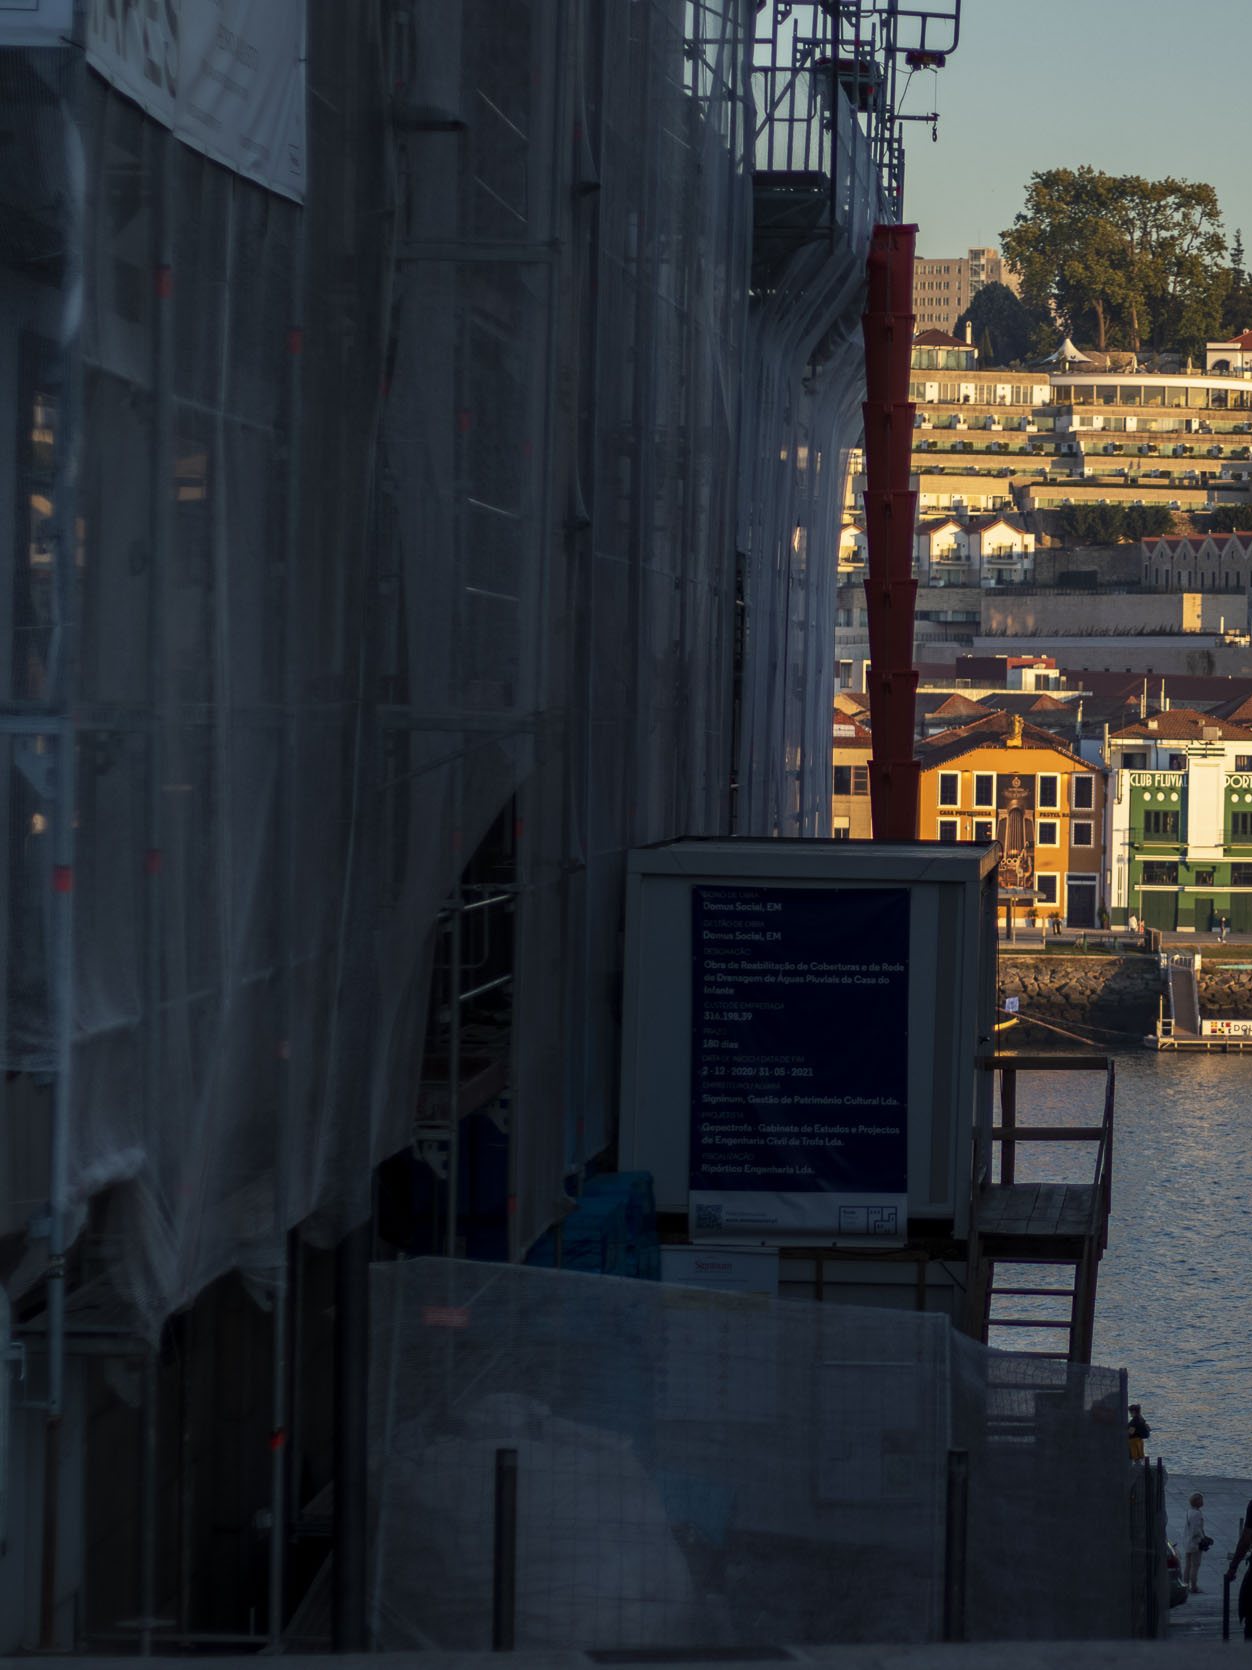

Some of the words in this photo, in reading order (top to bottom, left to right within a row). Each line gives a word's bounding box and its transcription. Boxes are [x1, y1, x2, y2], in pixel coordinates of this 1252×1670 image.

[1130, 774, 1153, 787] CLUB
[1155, 774, 1188, 788] FLUVIAL
[704, 902, 734, 911] Domus
[736, 902, 765, 912] Social,
[767, 903, 782, 911] EM
[704, 931, 734, 940] Domus
[736, 931, 765, 941] Social,
[766, 932, 782, 940] EM
[704, 960, 727, 969] Obra
[728, 961, 740, 969] de
[741, 961, 796, 971] Reabilitação
[797, 962, 809, 971] de
[810, 962, 860, 971] Coberturas
[882, 963, 905, 972] Rede
[717, 973, 763, 983] Drenagem
[764, 974, 777, 983] de
[777, 972, 805, 984] Águas
[806, 974, 840, 984] Pluviais
[854, 975, 876, 984] Casa
[878, 976, 890, 984] do
[704, 986, 736, 994] Infante
[703, 1039, 720, 1048] 180
[720, 1040, 739, 1048] dias
[702, 1094, 746, 1104] Signinum,
[748, 1095, 780, 1104] Gestão
[780, 1096, 792, 1104] de
[793, 1096, 842, 1105] Património
[843, 1096, 880, 1105] Cultural
[881, 1097, 900, 1105] Lda.
[759, 1123, 800, 1133] Gabinete
[800, 1124, 813, 1133] de
[814, 1124, 850, 1133] Estudos
[858, 1124, 901, 1135] Projectos
[702, 1136, 714, 1144] de
[715, 1136, 766, 1146] Engenharia
[766, 1136, 788, 1145] Civil
[801, 1136, 825, 1145] Trofa
[825, 1136, 846, 1146] Lda.
[702, 1163, 743, 1174] Ripórtico
[744, 1164, 795, 1175] Engenharia
[795, 1165, 816, 1174] Lda.
